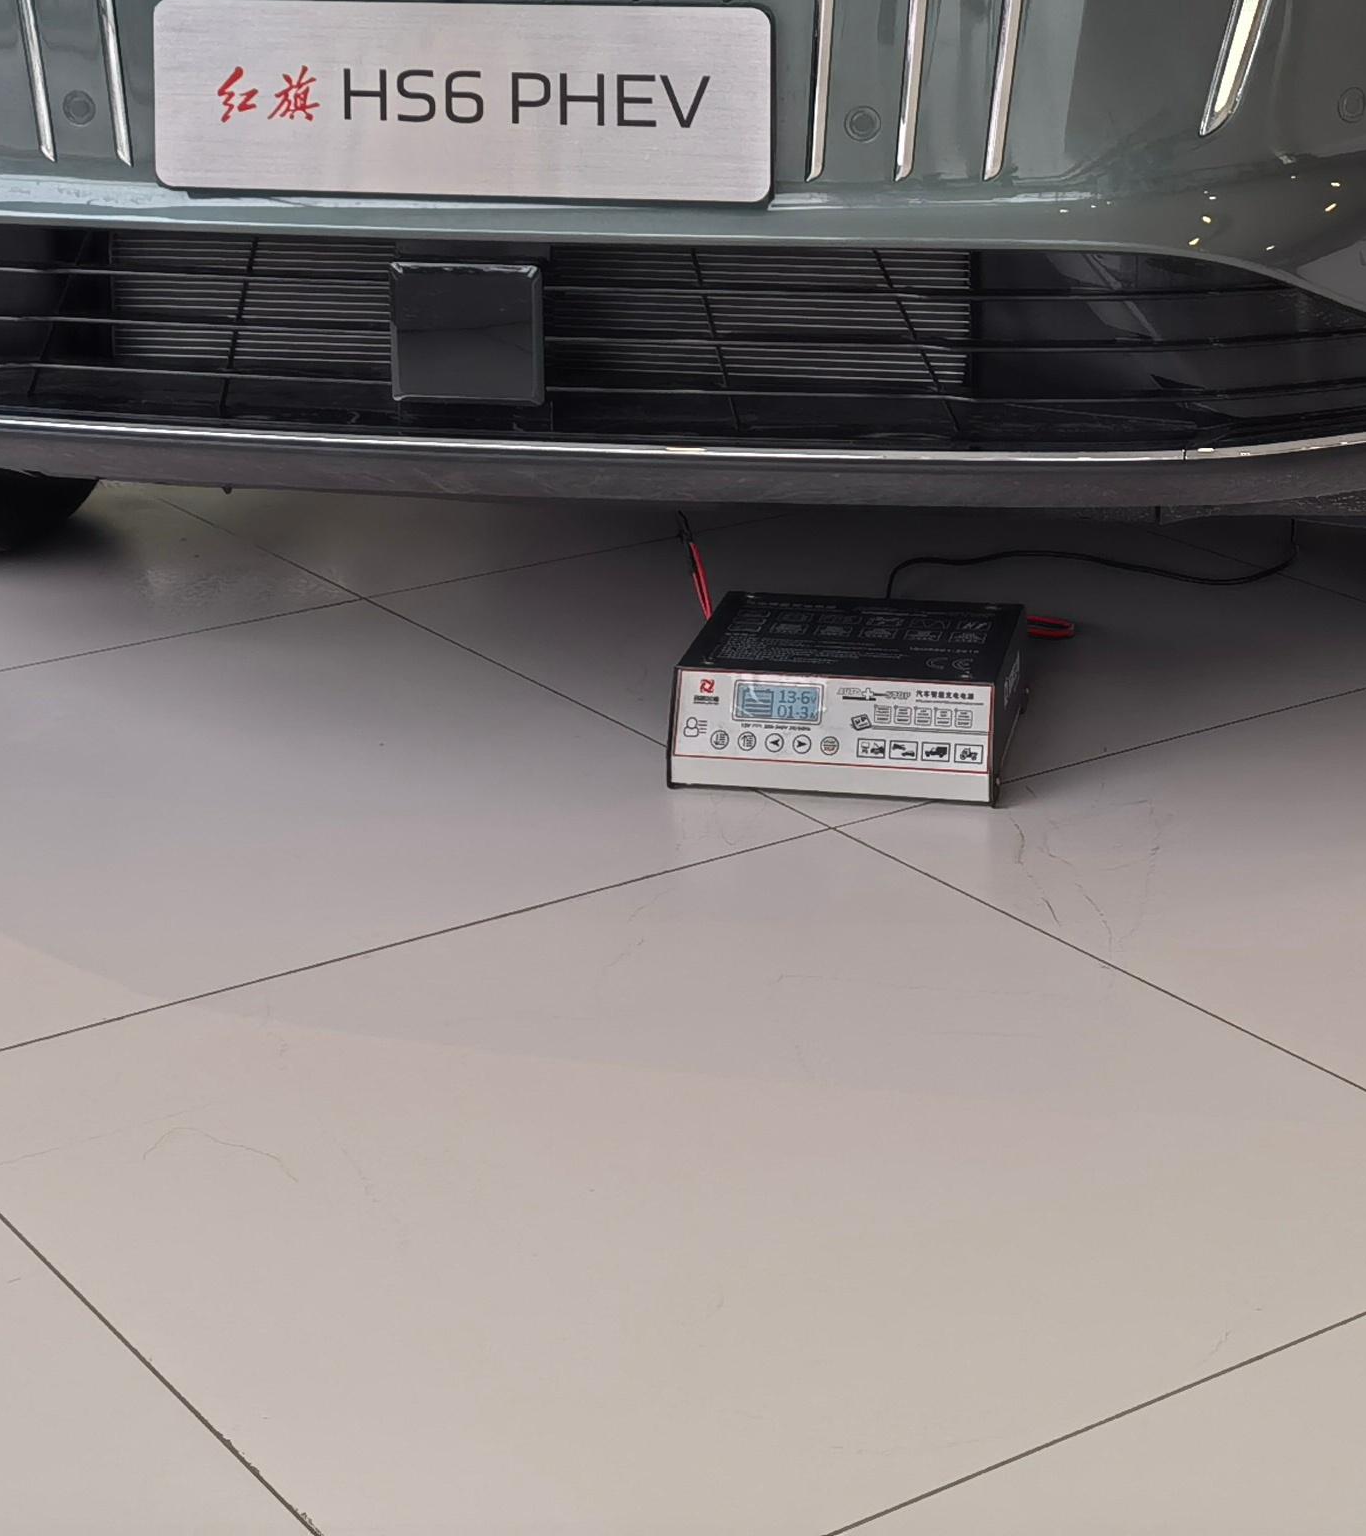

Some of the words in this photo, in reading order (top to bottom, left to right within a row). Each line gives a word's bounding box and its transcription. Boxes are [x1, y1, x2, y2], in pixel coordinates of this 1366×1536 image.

[217, 64, 321, 124] 红旗
[343, 67, 484, 124] HS6
[511, 71, 711, 129] PHEV
